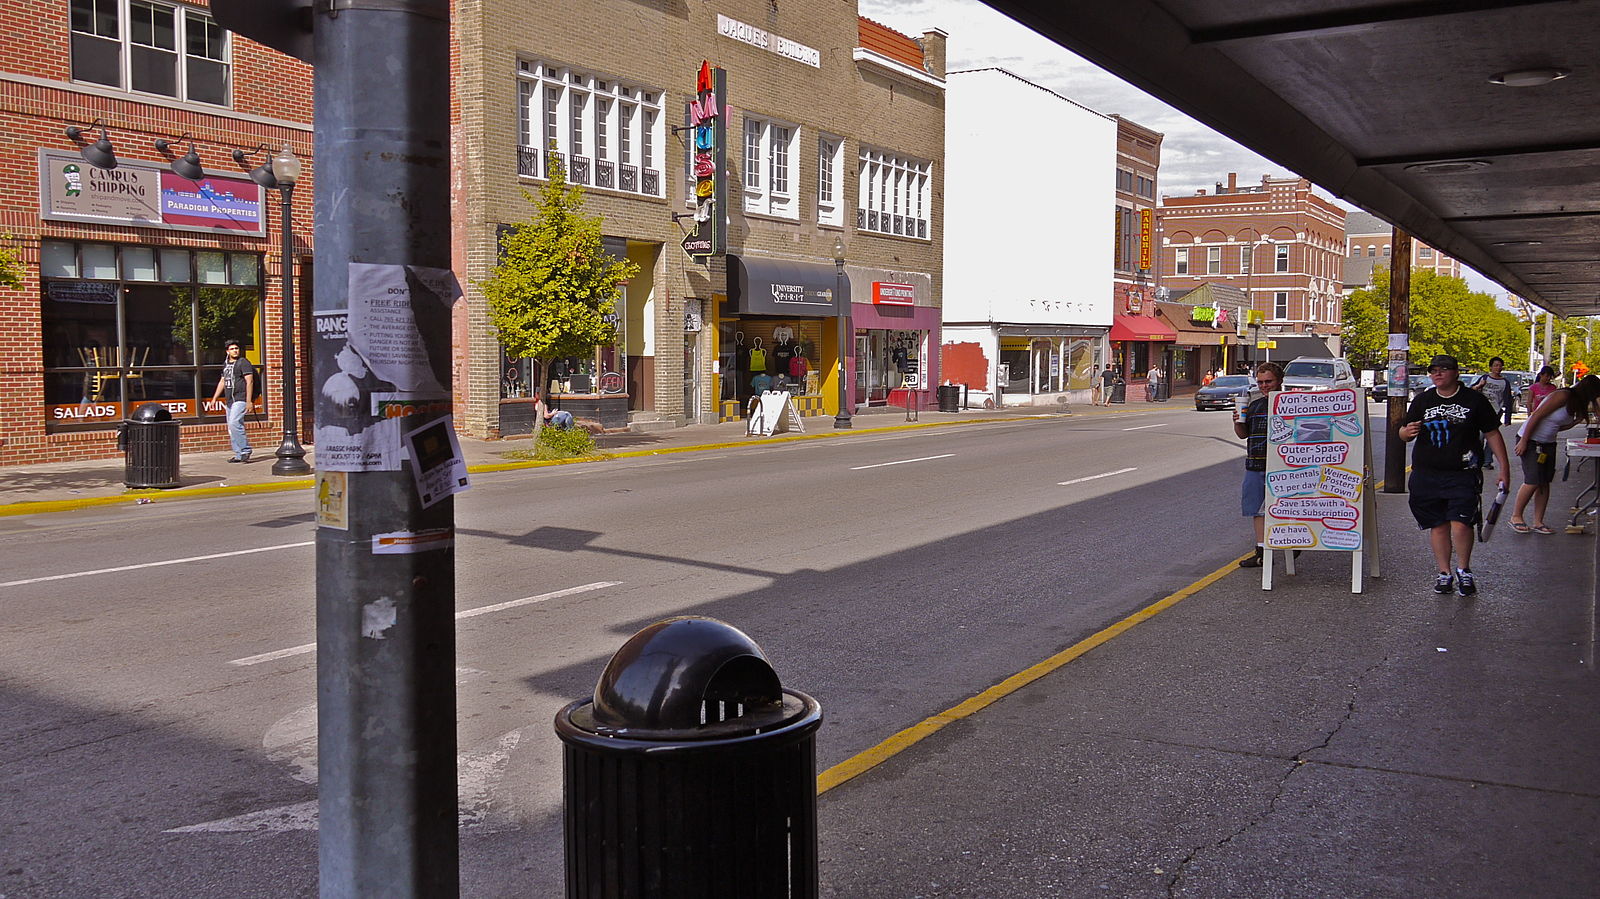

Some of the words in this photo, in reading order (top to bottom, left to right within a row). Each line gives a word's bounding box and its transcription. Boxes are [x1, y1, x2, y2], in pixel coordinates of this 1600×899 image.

[722, 20, 768, 49] JAQUES
[777, 39, 818, 66] BUILDING
[89, 167, 138, 184] CAMPUS
[89, 180, 145, 197] SHIPPING
[167, 200, 209, 213] PARADIGM
[211, 205, 257, 218] PROPERTIES
[770, 283, 804, 296] UNIVERSITY
[1280, 394, 1308, 404] Von's
[1311, 392, 1351, 403] Records
[53, 405, 116, 419] SALADS
[1277, 404, 1330, 415] Welcomes
[1332, 403, 1352, 412] Our
[1315, 444, 1345, 455] Space
[1287, 453, 1341, 464] Overlords!
[1269, 473, 1288, 484] DVD
[1289, 468, 1320, 481] Rentals
[1324, 467, 1360, 484] Weirdest
[1274, 485, 1285, 493] $1
[1286, 484, 1300, 492] per
[1301, 482, 1317, 490] day
[1325, 475, 1355, 490] Posters
[1330, 485, 1356, 498] Town!
[1279, 500, 1299, 508] Save
[1301, 500, 1318, 508] 15%
[1318, 499, 1338, 507] with
[1271, 507, 1300, 515] Comics
[1302, 508, 1354, 519] Subscription
[1287, 525, 1308, 533] have
[1268, 536, 1311, 546] Textbooks
